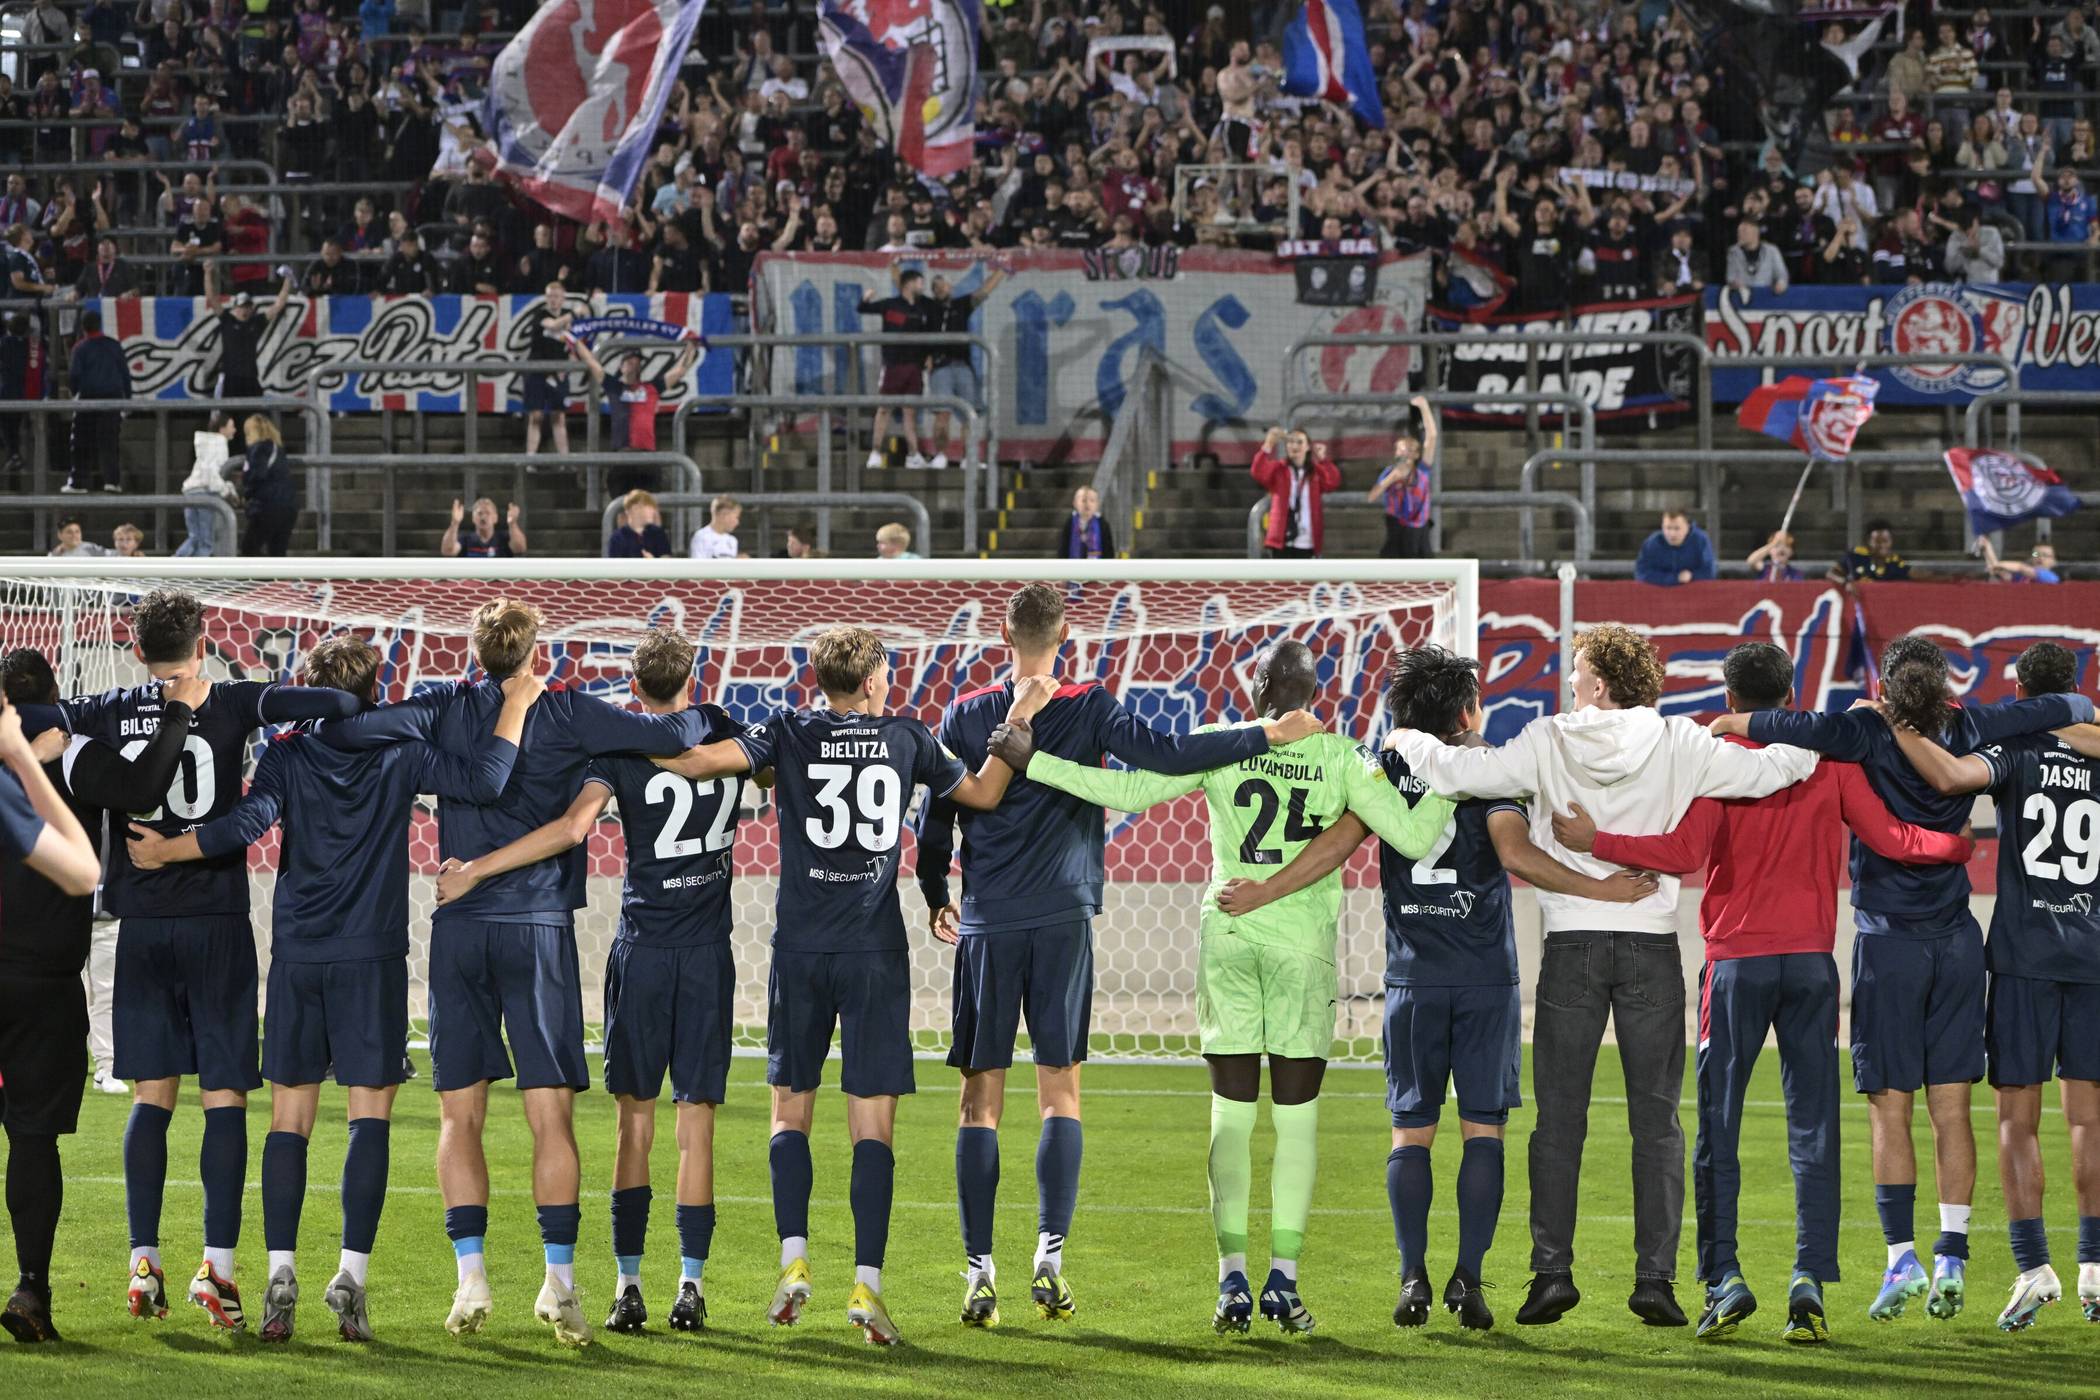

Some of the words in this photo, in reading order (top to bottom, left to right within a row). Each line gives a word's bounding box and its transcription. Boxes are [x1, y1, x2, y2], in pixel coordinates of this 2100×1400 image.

[125, 301, 357, 394] Alez
[1706, 284, 1885, 387] Sport
[2026, 284, 2100, 367] Ve
[821, 741, 889, 759] BIELITZA
[1398, 775, 1430, 794] NISH
[644, 771, 739, 859] 22
[805, 764, 901, 852] 39
[1234, 778, 1324, 864] 24
[1411, 812, 1458, 885] 2
[2022, 793, 2100, 885] 29
[662, 878, 682, 890] MSS
[1400, 904, 1418, 915] MSS
